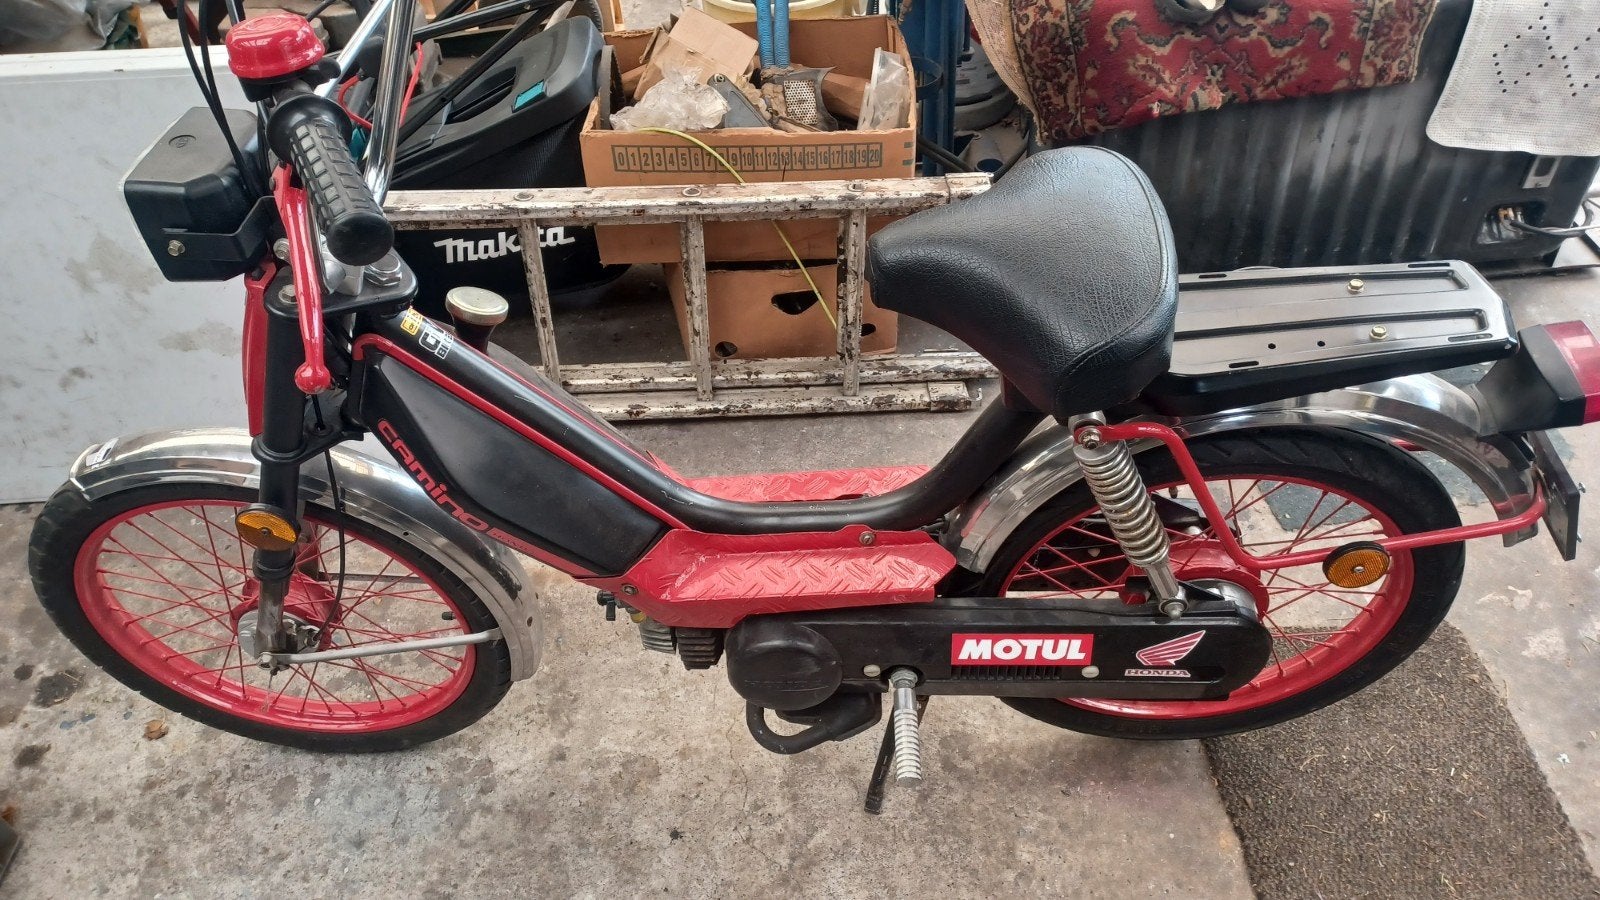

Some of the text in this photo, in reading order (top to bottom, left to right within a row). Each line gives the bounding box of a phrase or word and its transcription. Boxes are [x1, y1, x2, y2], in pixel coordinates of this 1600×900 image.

[618, 152, 625, 166] 0
[631, 152, 636, 166] 1
[643, 152, 650, 166] 2
[656, 152, 663, 166] 3
[668, 152, 675, 166] 4
[681, 152, 687, 167] 5
[693, 152, 700, 166] 6
[706, 152, 713, 167] 7
[731, 152, 738, 166] 9
[743, 152, 752, 166] 10
[755, 152, 764, 166] 11
[768, 151, 777, 166] 12
[781, 151, 790, 165] 13
[793, 151, 803, 165] 14
[806, 150, 815, 165] 15
[819, 151, 828, 164] 16
[831, 150, 841, 164] 17
[844, 150, 854, 163] 18
[857, 149, 866, 163] 19
[869, 149, 880, 162] 20
[958, 638, 1086, 661] MOTUL
[1126, 669, 1190, 677] HONDA
